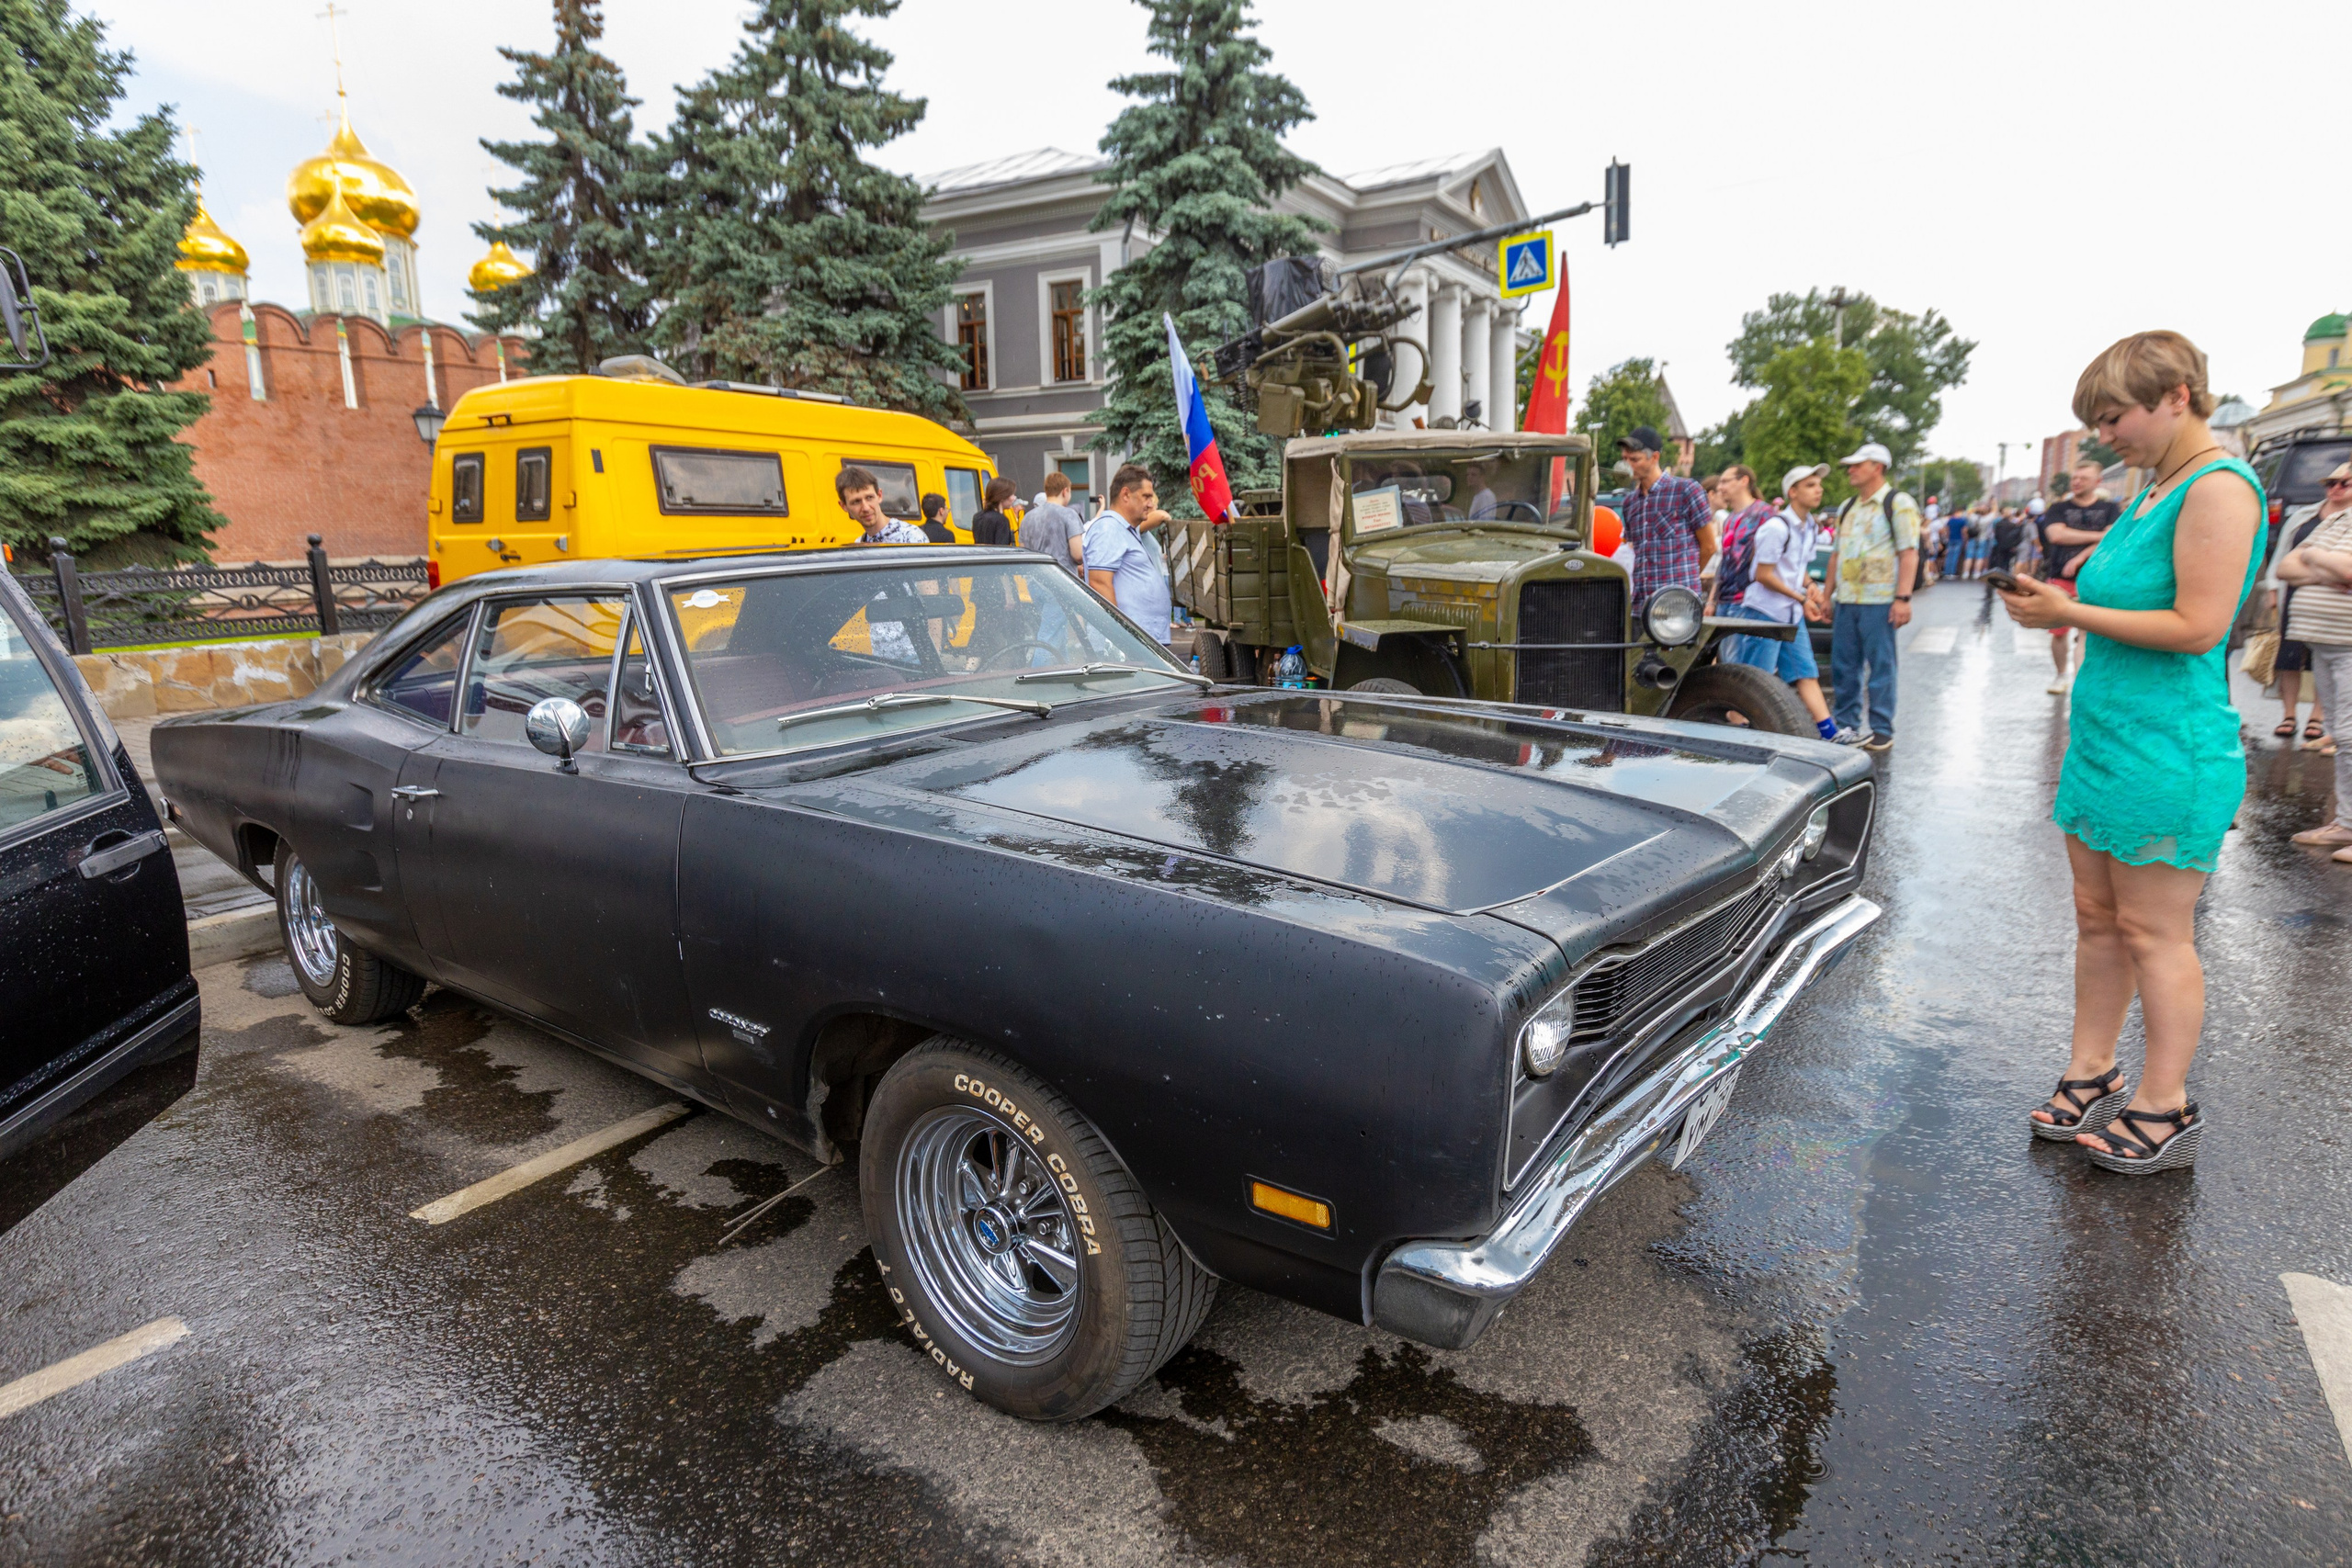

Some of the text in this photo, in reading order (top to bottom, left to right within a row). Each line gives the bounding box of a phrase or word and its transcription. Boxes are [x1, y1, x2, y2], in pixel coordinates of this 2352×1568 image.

[334, 953, 351, 1010] COOPER
[954, 1073, 1102, 1256] COOPER COBRA
[904, 1308, 975, 1391] RADIAL
